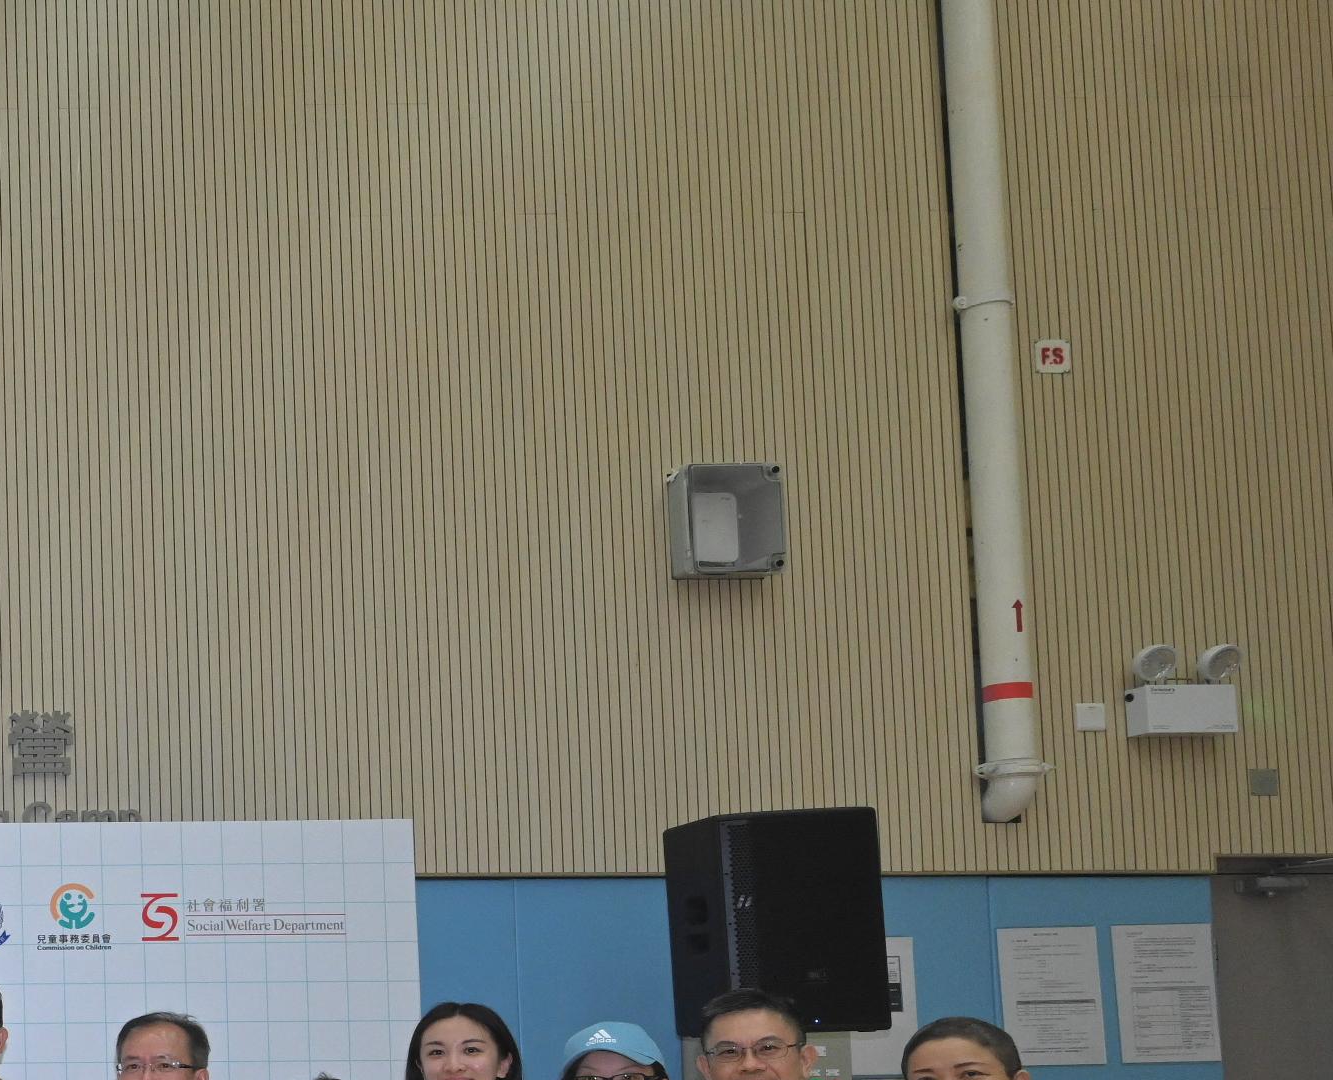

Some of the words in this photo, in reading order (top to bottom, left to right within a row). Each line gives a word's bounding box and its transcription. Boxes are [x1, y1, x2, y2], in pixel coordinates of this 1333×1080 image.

[187, 919, 224, 931] Social
[226, 918, 271, 931] Welfare
[273, 918, 344, 933] Department
[36, 933, 112, 944] 兒童事務委員會
[586, 1036, 617, 1047] adidas
